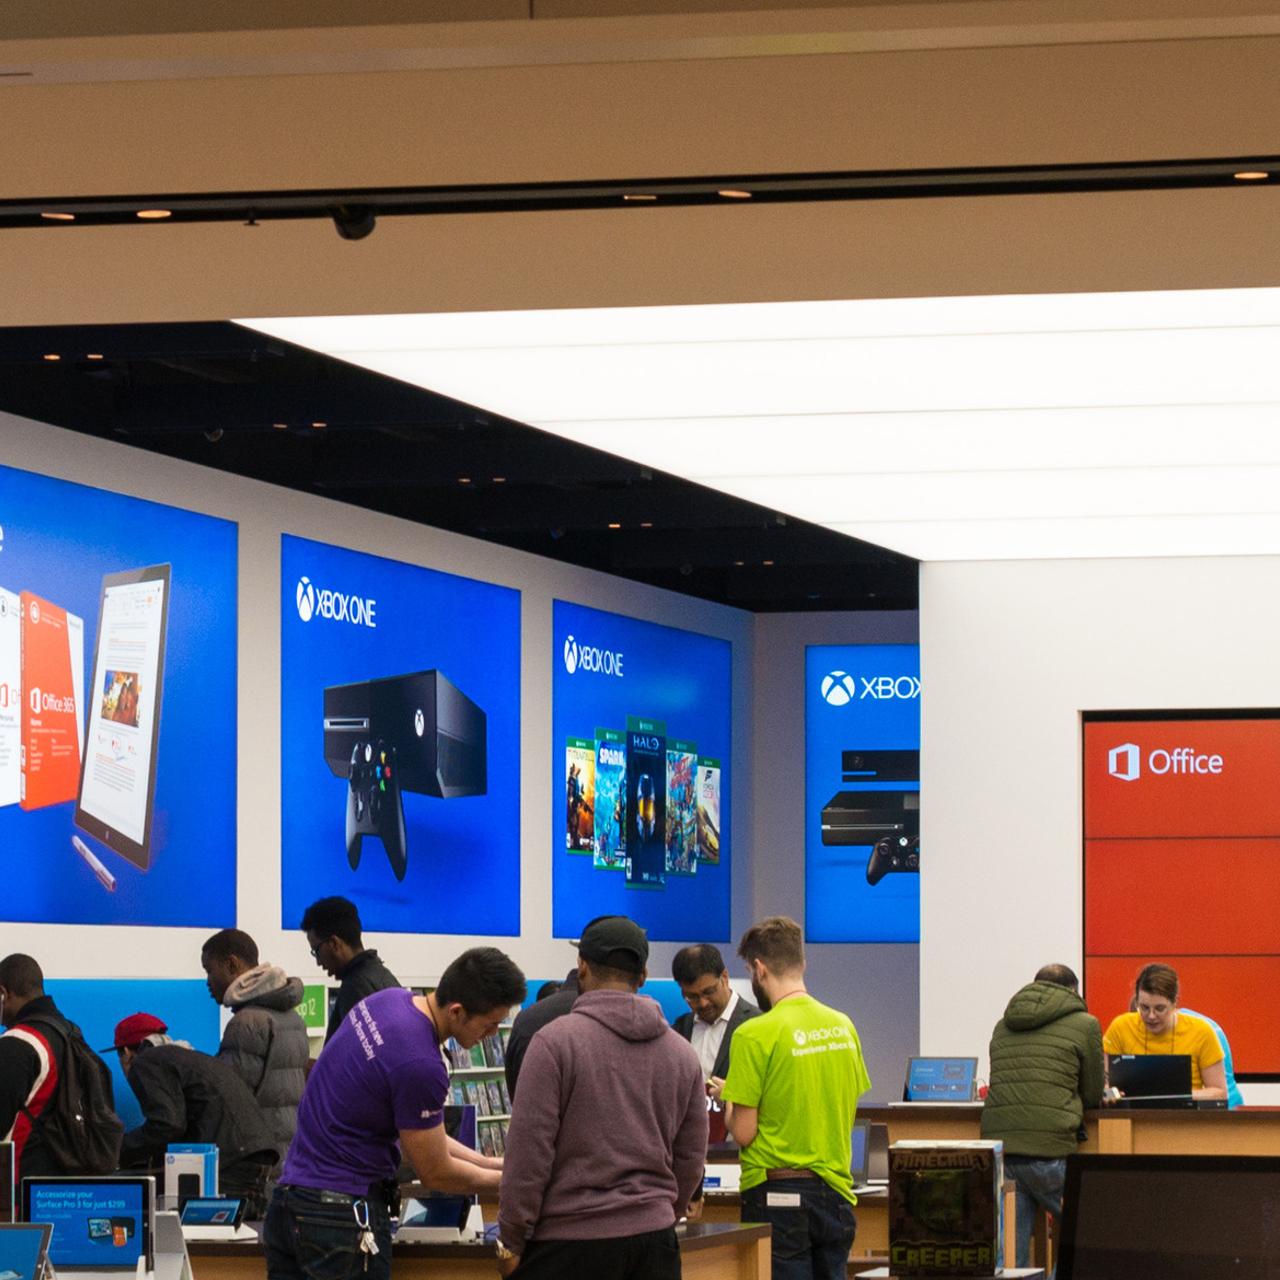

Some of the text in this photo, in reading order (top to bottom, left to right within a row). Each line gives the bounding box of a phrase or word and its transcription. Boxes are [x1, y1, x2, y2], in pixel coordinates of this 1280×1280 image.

[315, 588, 377, 628] XBOX ONE
[578, 644, 624, 677] XBOX ONE
[633, 735, 659, 750] HALO
[1148, 747, 1224, 775] Office
[36, 1191, 94, 1200] Accessorize your
[36, 1200, 62, 1208] Surface
[93, 1201, 107, 1210] just
[892, 1245, 991, 1267] CREEPER
